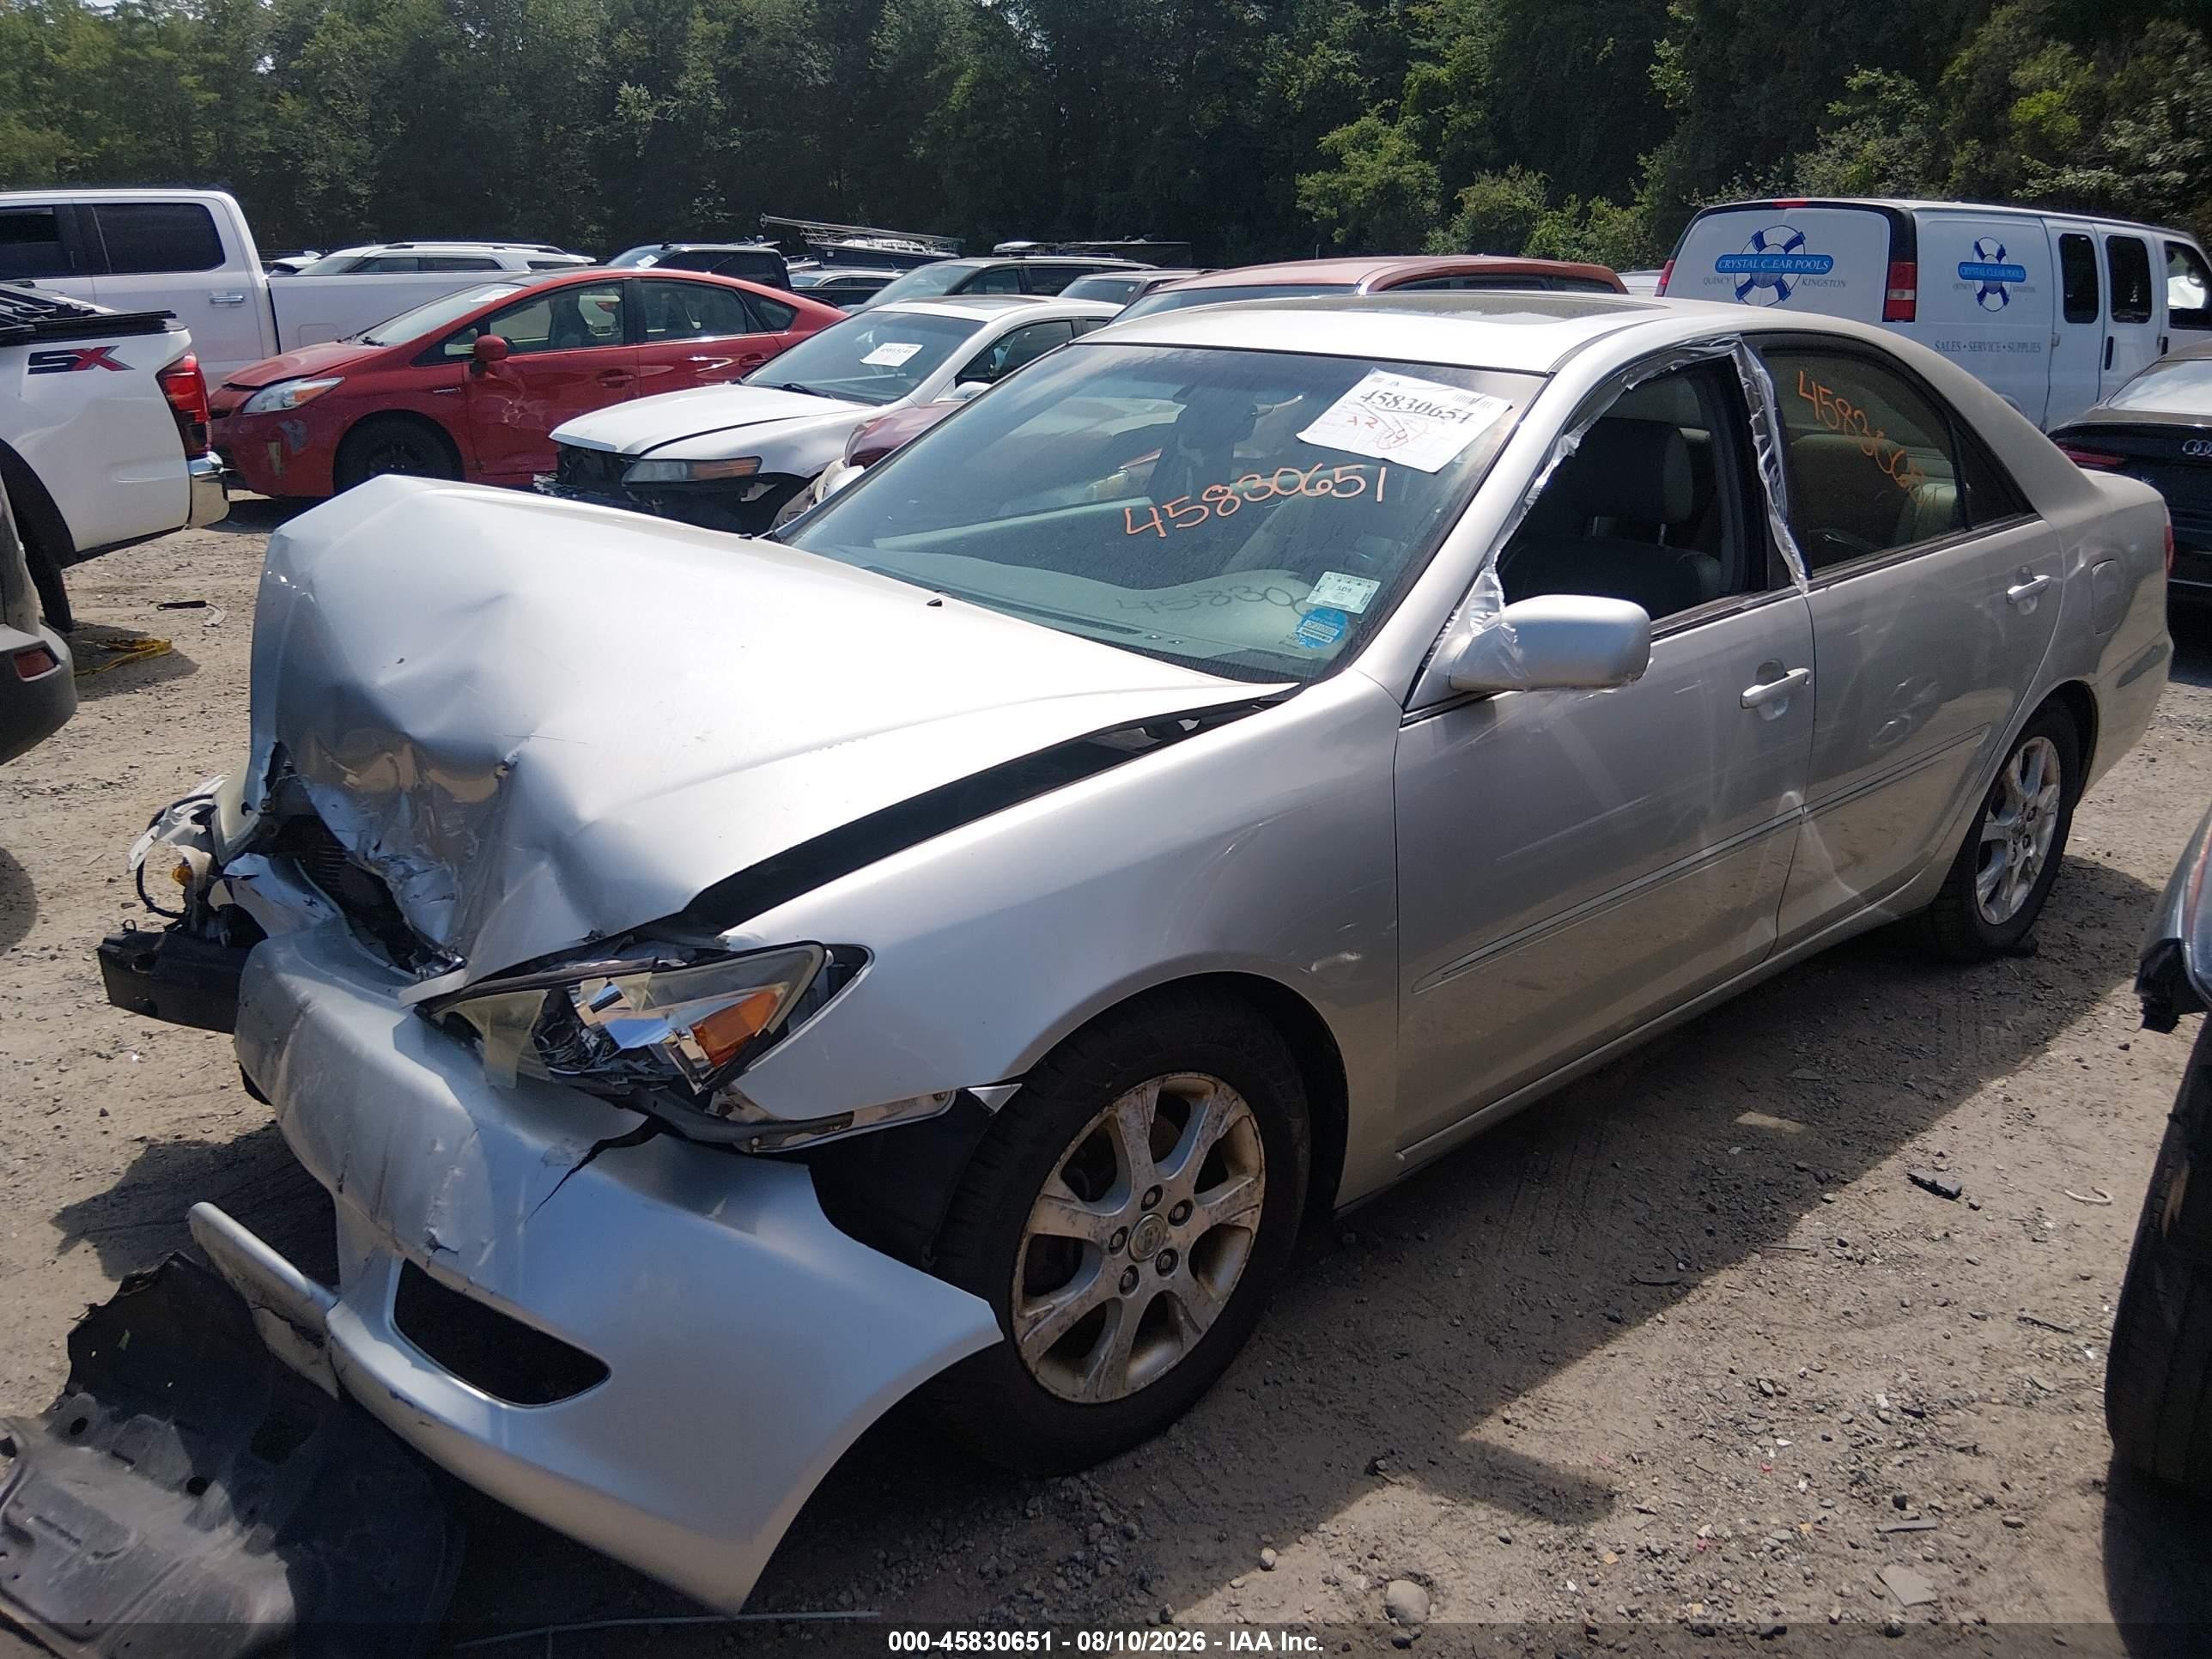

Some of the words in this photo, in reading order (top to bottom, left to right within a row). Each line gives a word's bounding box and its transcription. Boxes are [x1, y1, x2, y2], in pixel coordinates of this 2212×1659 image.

[1718, 259, 1758, 270] CRYSTAL
[1794, 259, 1831, 270] POOLS
[1801, 278, 1847, 288] KINGSTON
[1935, 341, 1961, 352] SALES
[1968, 341, 2001, 352] SERVICE
[2007, 342, 2041, 353] SUPPLIES
[1360, 389, 1474, 425] 45830651
[1125, 463, 1387, 537] 45830651
